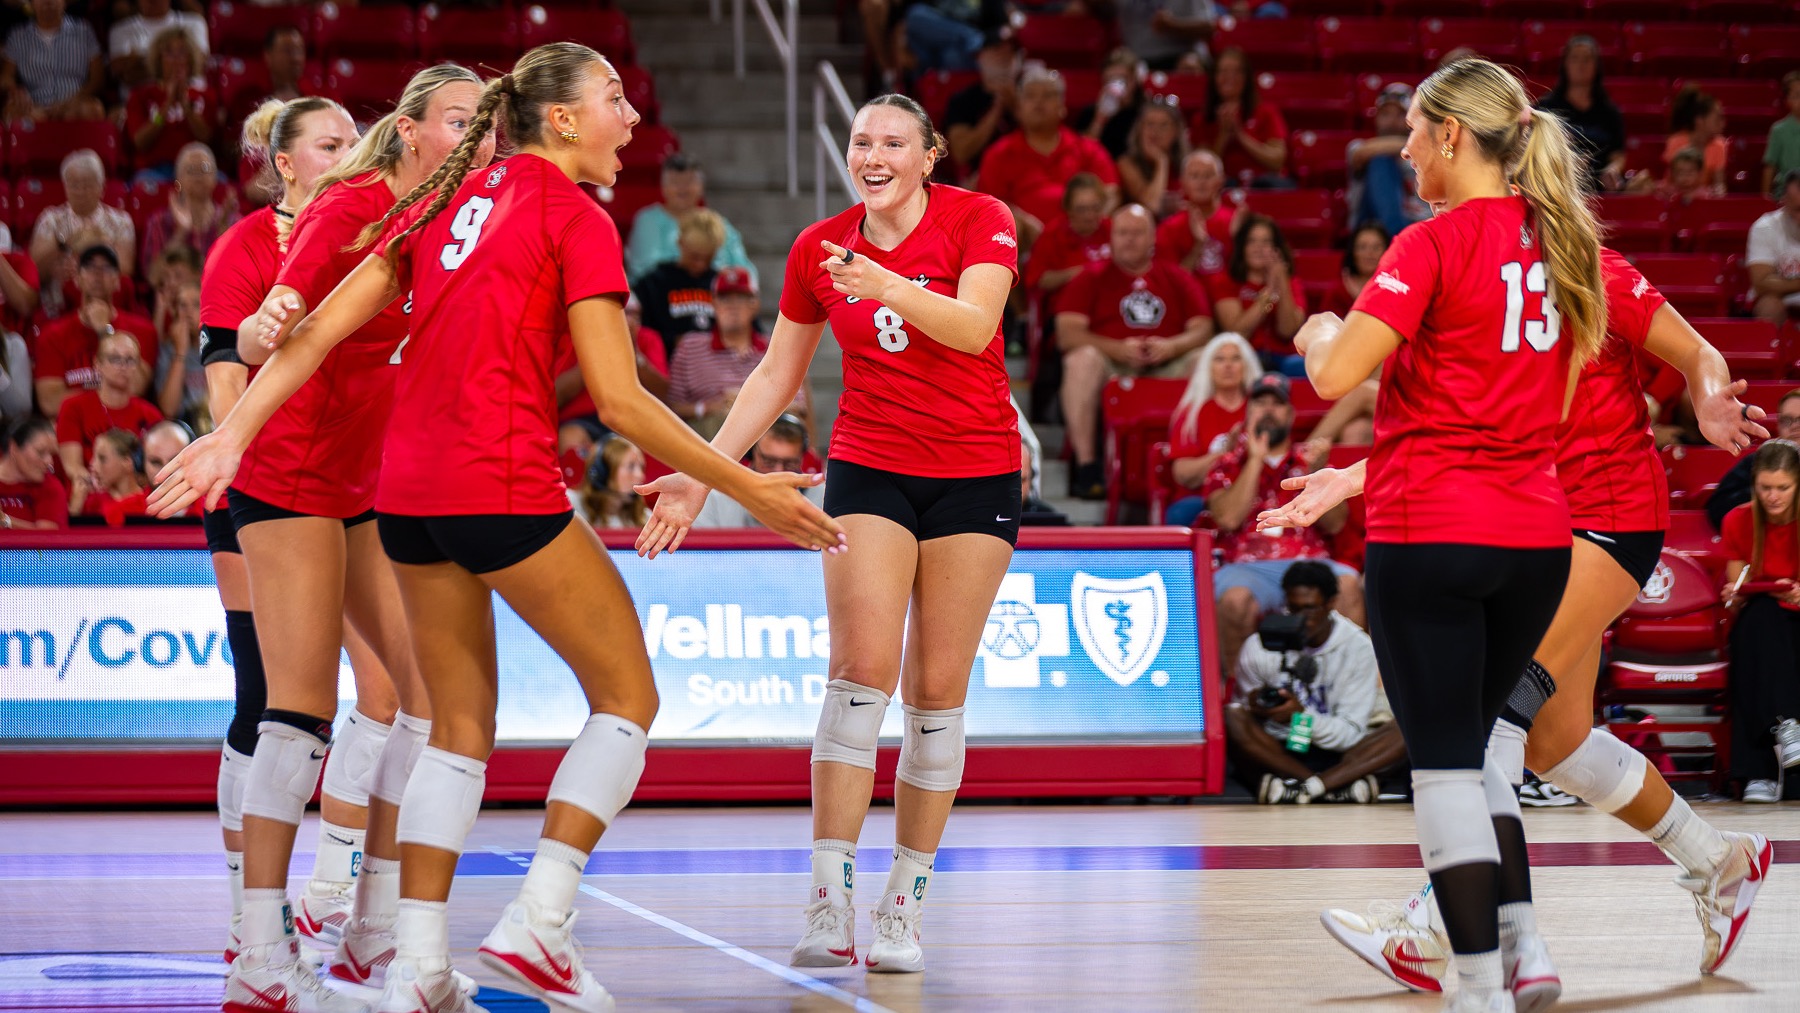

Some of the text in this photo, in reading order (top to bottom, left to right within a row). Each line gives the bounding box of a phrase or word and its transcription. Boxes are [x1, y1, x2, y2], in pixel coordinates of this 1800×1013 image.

[440, 195, 495, 271] 9
[873, 306, 910, 353] 8
[1500, 261, 1562, 353] 13
[687, 673, 795, 706] South
